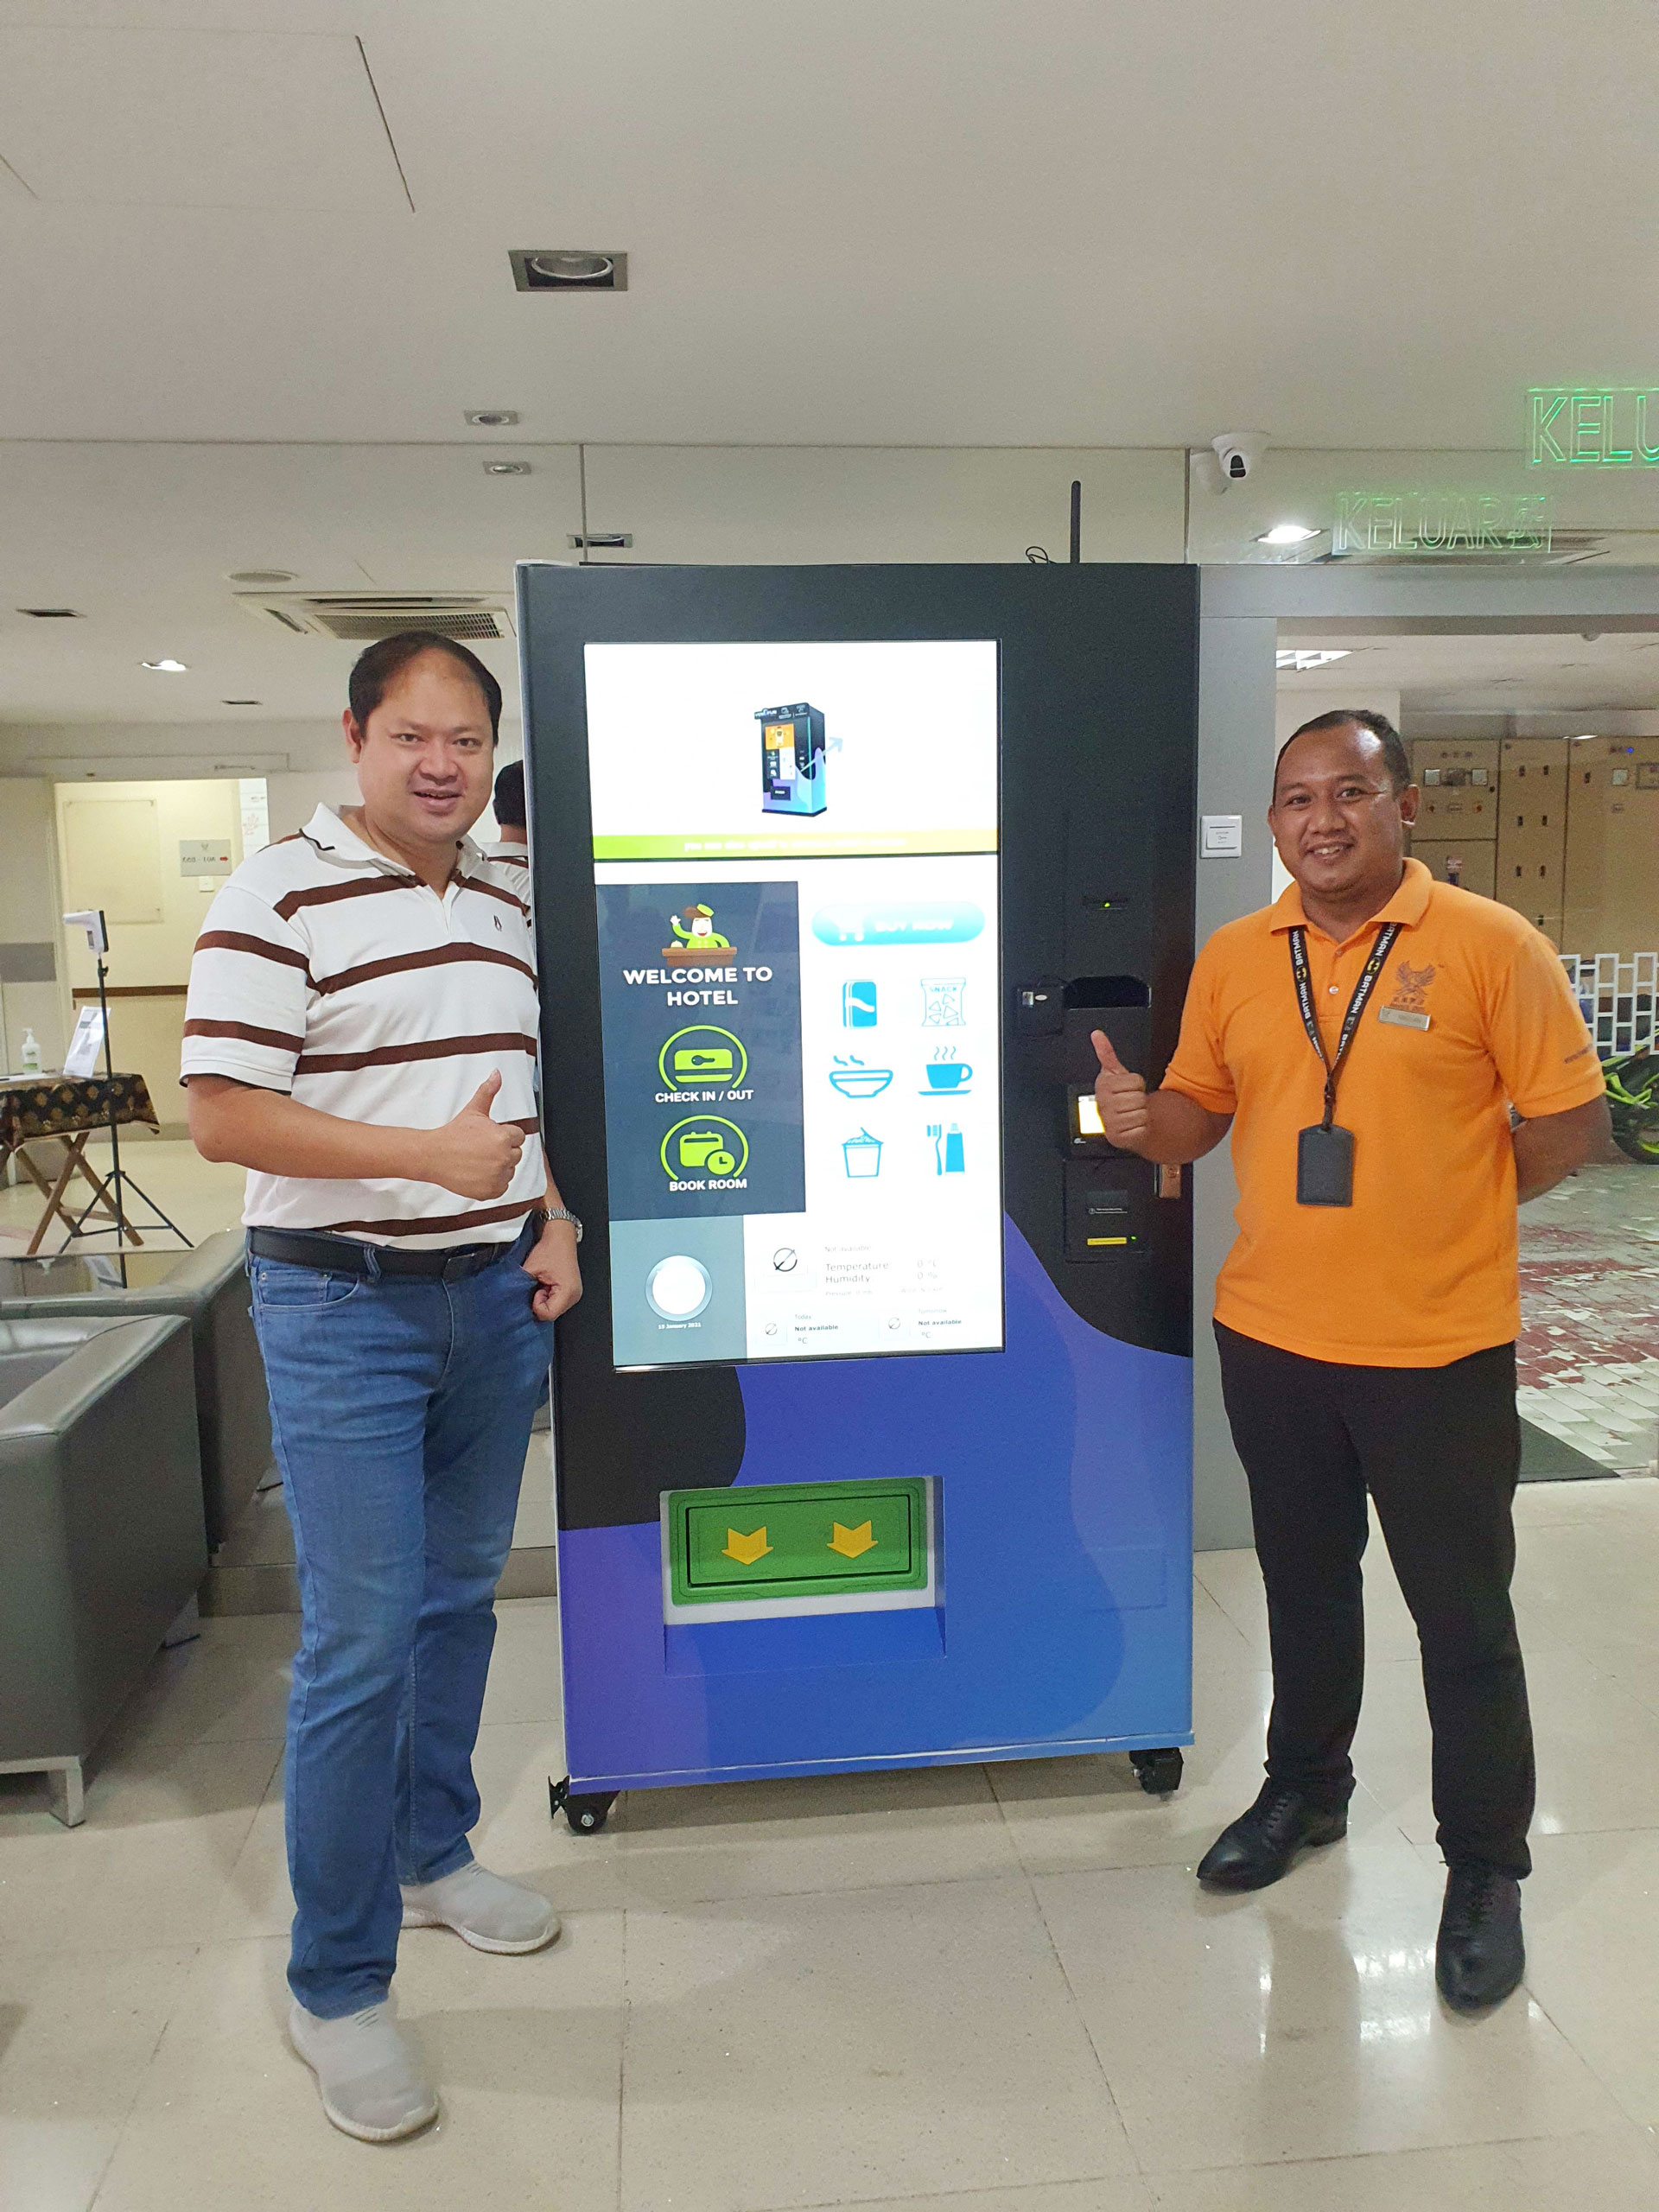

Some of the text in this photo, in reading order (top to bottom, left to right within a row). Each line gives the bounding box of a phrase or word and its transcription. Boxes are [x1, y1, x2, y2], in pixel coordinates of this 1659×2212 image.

[1338, 497, 1504, 550] KELUAR
[1292, 931, 1304, 966] BATMAN
[622, 966, 773, 985] WELCOME TO
[667, 990, 739, 1007] HOTEL
[1300, 982, 1311, 1020] BATMAN
[1351, 975, 1373, 1014] BATMAN
[655, 1090, 754, 1103] CHECK IN / OUT
[669, 1178, 747, 1192] BOOK ROOM
